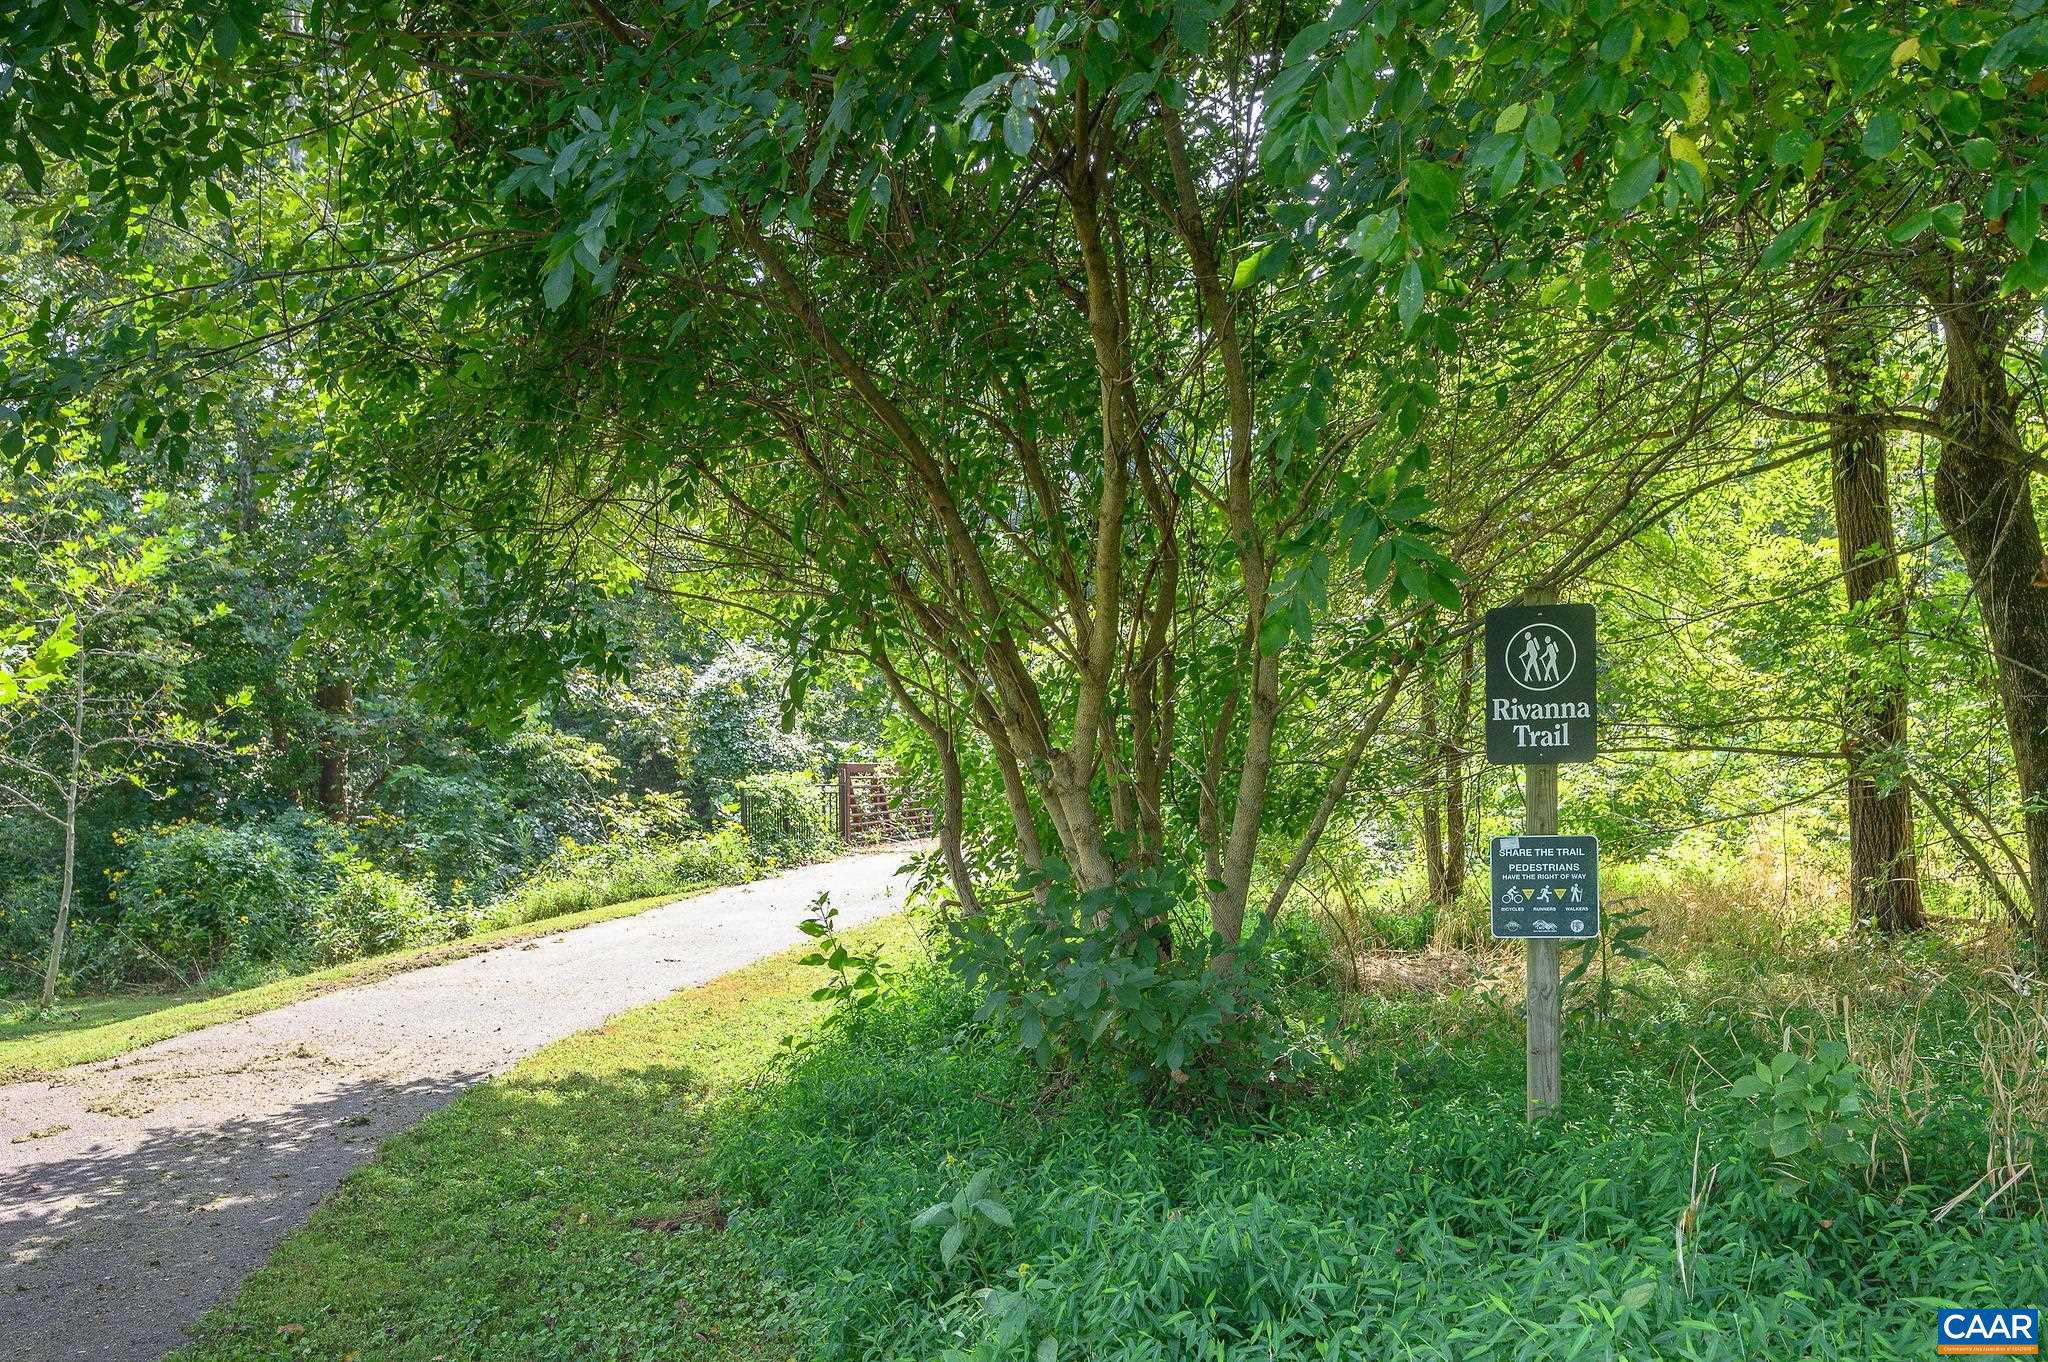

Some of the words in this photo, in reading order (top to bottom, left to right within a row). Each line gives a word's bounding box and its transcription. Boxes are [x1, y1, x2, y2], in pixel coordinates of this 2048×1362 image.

[1492, 698, 1591, 720] Rivanna
[1512, 722, 1570, 747] Trail
[1499, 848, 1532, 857] SHARE
[1534, 848, 1554, 856] THE
[1556, 848, 1585, 856] TRAIL
[1508, 863, 1580, 872] PEDESTRIANS
